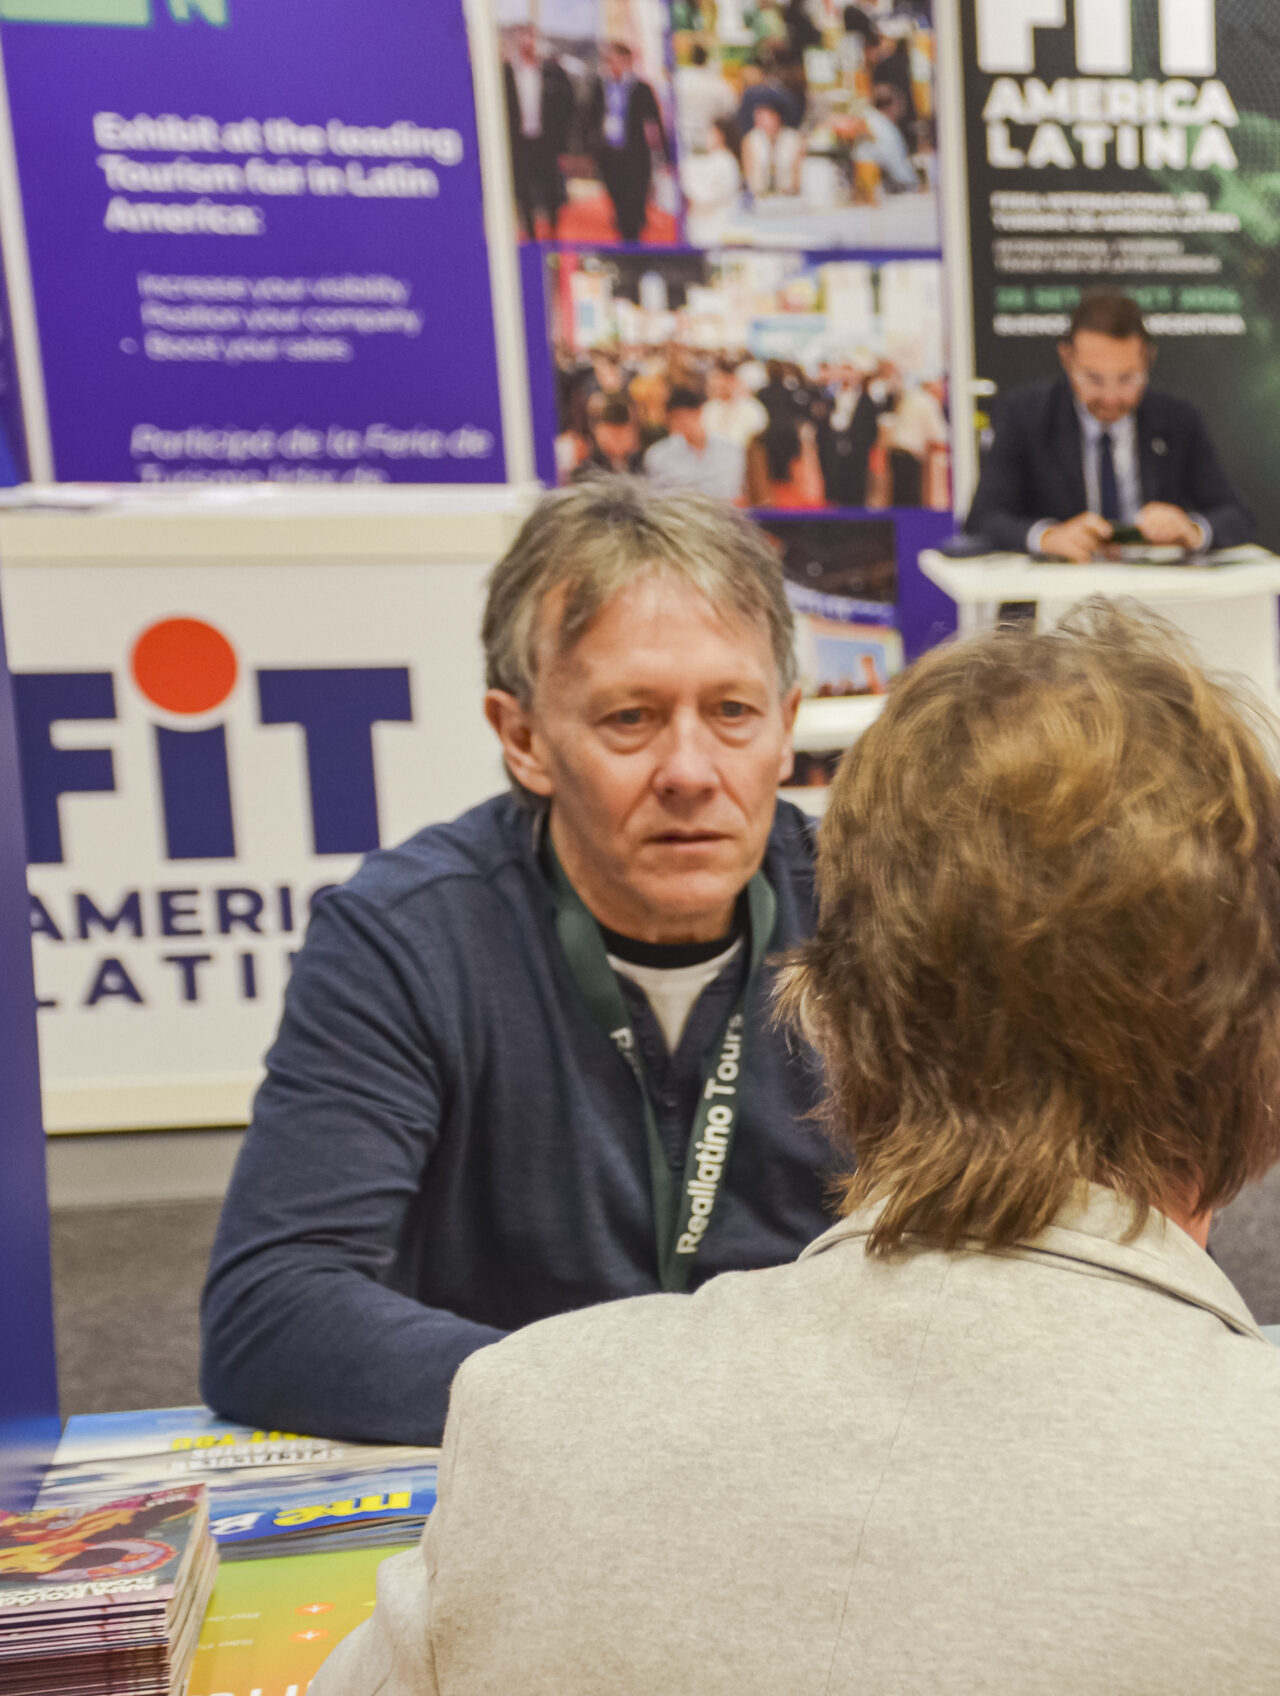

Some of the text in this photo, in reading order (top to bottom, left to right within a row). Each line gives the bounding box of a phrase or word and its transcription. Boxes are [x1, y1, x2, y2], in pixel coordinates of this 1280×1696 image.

[983, 77, 1239, 127] AMERICA
[94, 113, 464, 165] Exhibit at the leading
[986, 120, 1239, 170] LATINA
[98, 155, 439, 198] Tourism fair in Latin
[676, 1013, 744, 1254] Reallatino Tours
